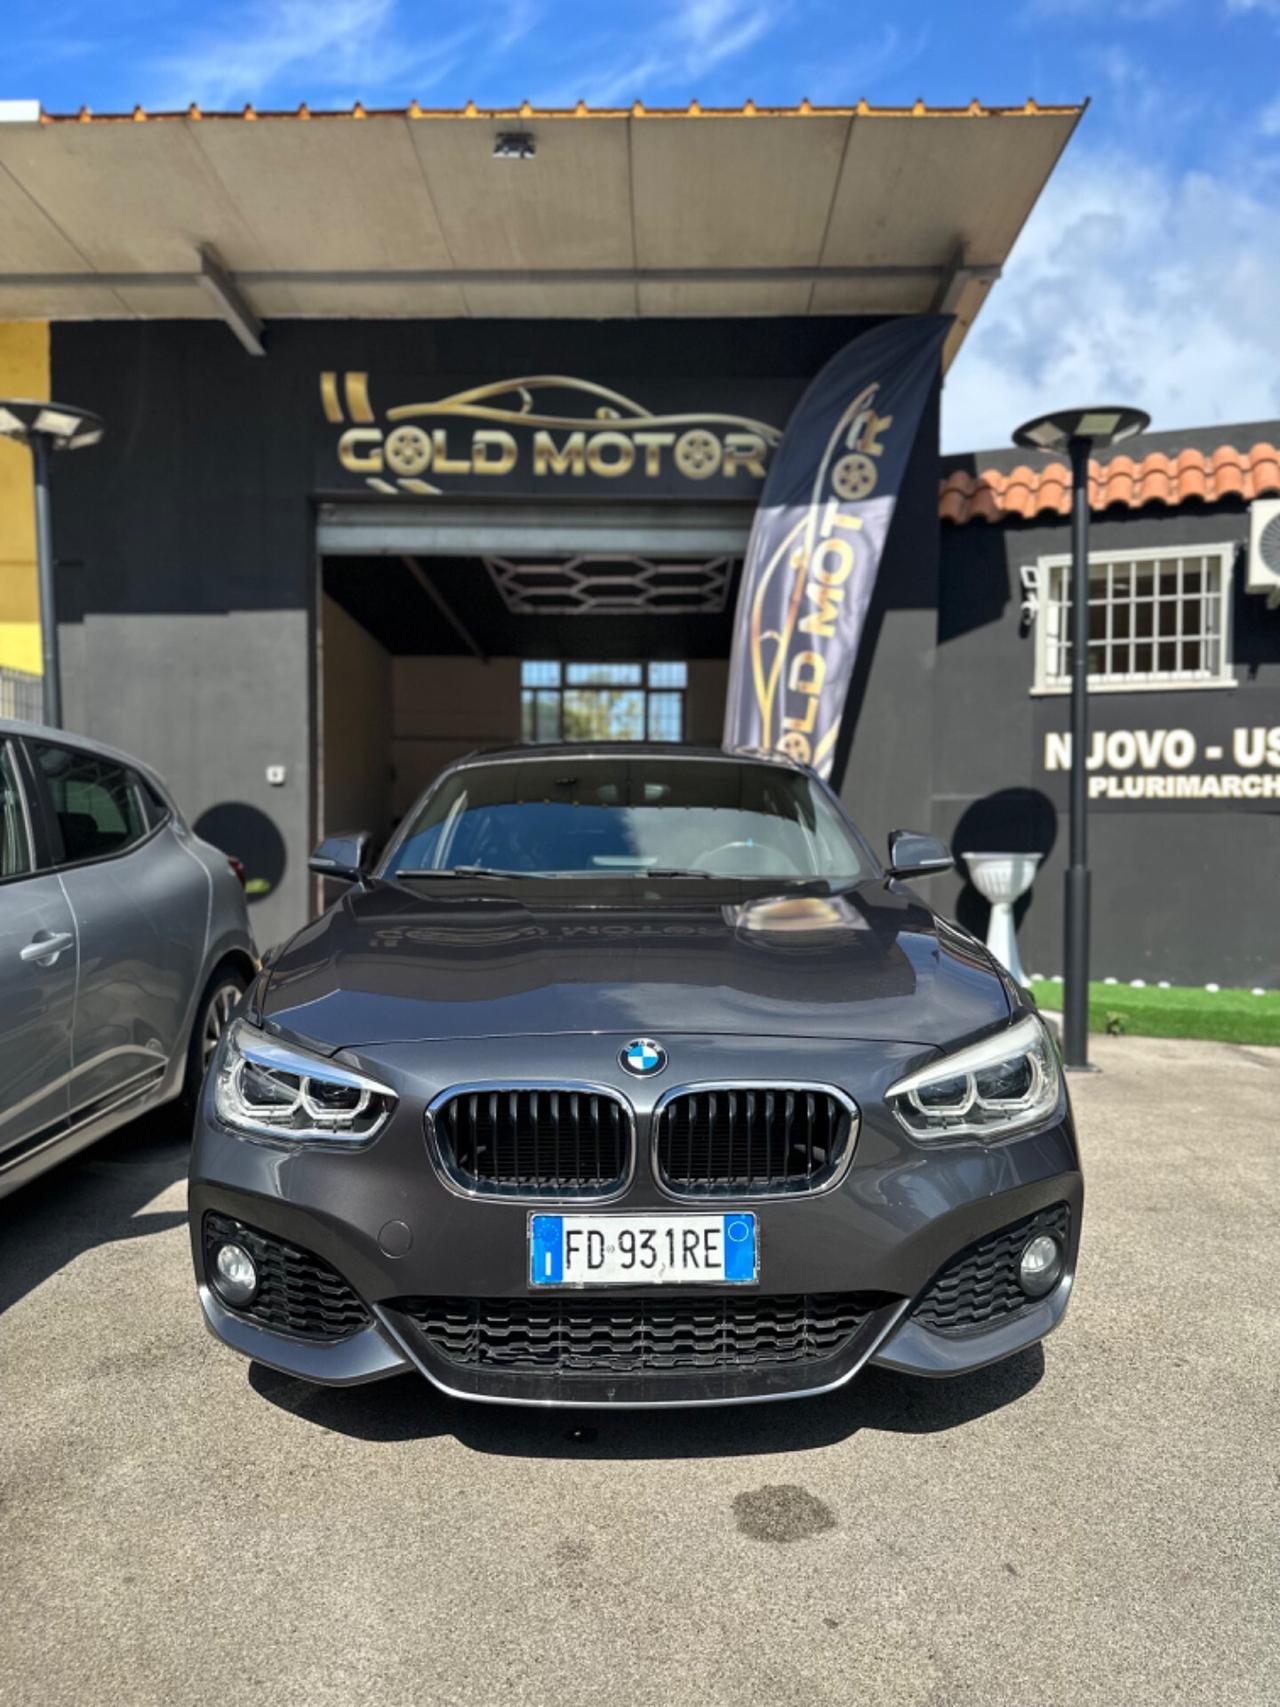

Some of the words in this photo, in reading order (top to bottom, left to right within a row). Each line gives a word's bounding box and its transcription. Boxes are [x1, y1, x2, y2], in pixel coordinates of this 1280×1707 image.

[338, 425, 517, 476] GOLD
[534, 429, 767, 479] MOTOR
[798, 408, 894, 638] MOTOR
[565, 1230, 605, 1270] FD
[618, 1228, 722, 1270] 931RE
